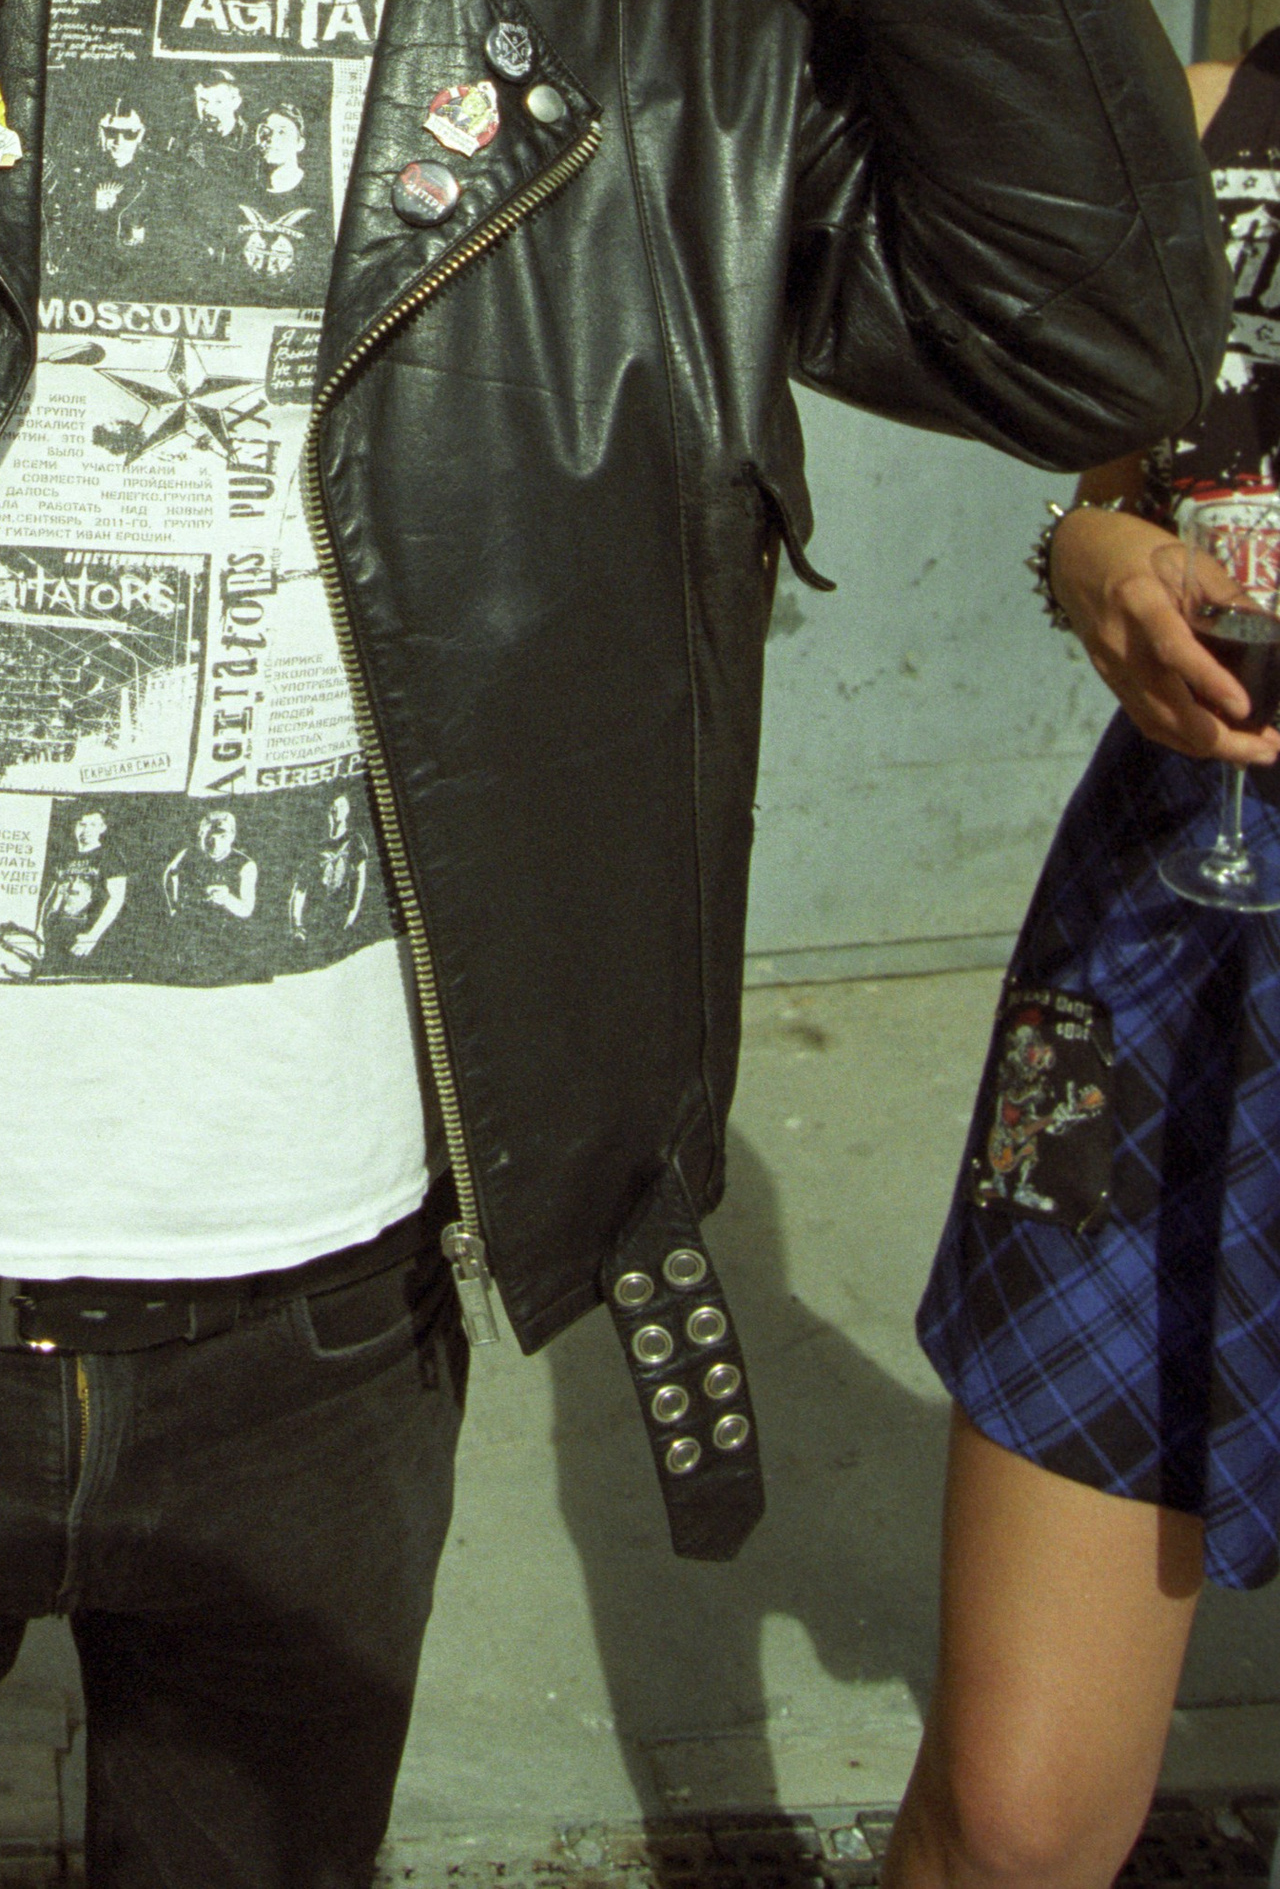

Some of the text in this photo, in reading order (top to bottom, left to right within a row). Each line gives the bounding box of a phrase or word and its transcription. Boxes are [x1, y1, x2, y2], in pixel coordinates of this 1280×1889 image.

[49, 394, 87, 405] ИЮЛЕ
[37, 407, 86, 418] ГРУППУ
[17, 418, 86, 430] ВОКАЛИСТ
[61, 434, 86, 444] ЭТО
[47, 446, 84, 458] БЫЛО
[13, 459, 58, 470] ВСЕМИ
[82, 462, 176, 475] УЧАСТНИКАМИ
[22, 473, 100, 485] СОВМЕСТНО
[123, 477, 213, 490] ПРОЙДЕННЫЙ
[38, 501, 102, 513] РАБОТАТЬ
[121, 505, 148, 516] НАД
[166, 506, 214, 517] НОВЫМ
[163, 518, 214, 530] ГРУППУ
[6, 527, 72, 539] ГИТАРИСТ
[77, 530, 111, 541] ИВАН
[0, 883, 38, 896] ЧЕГО
